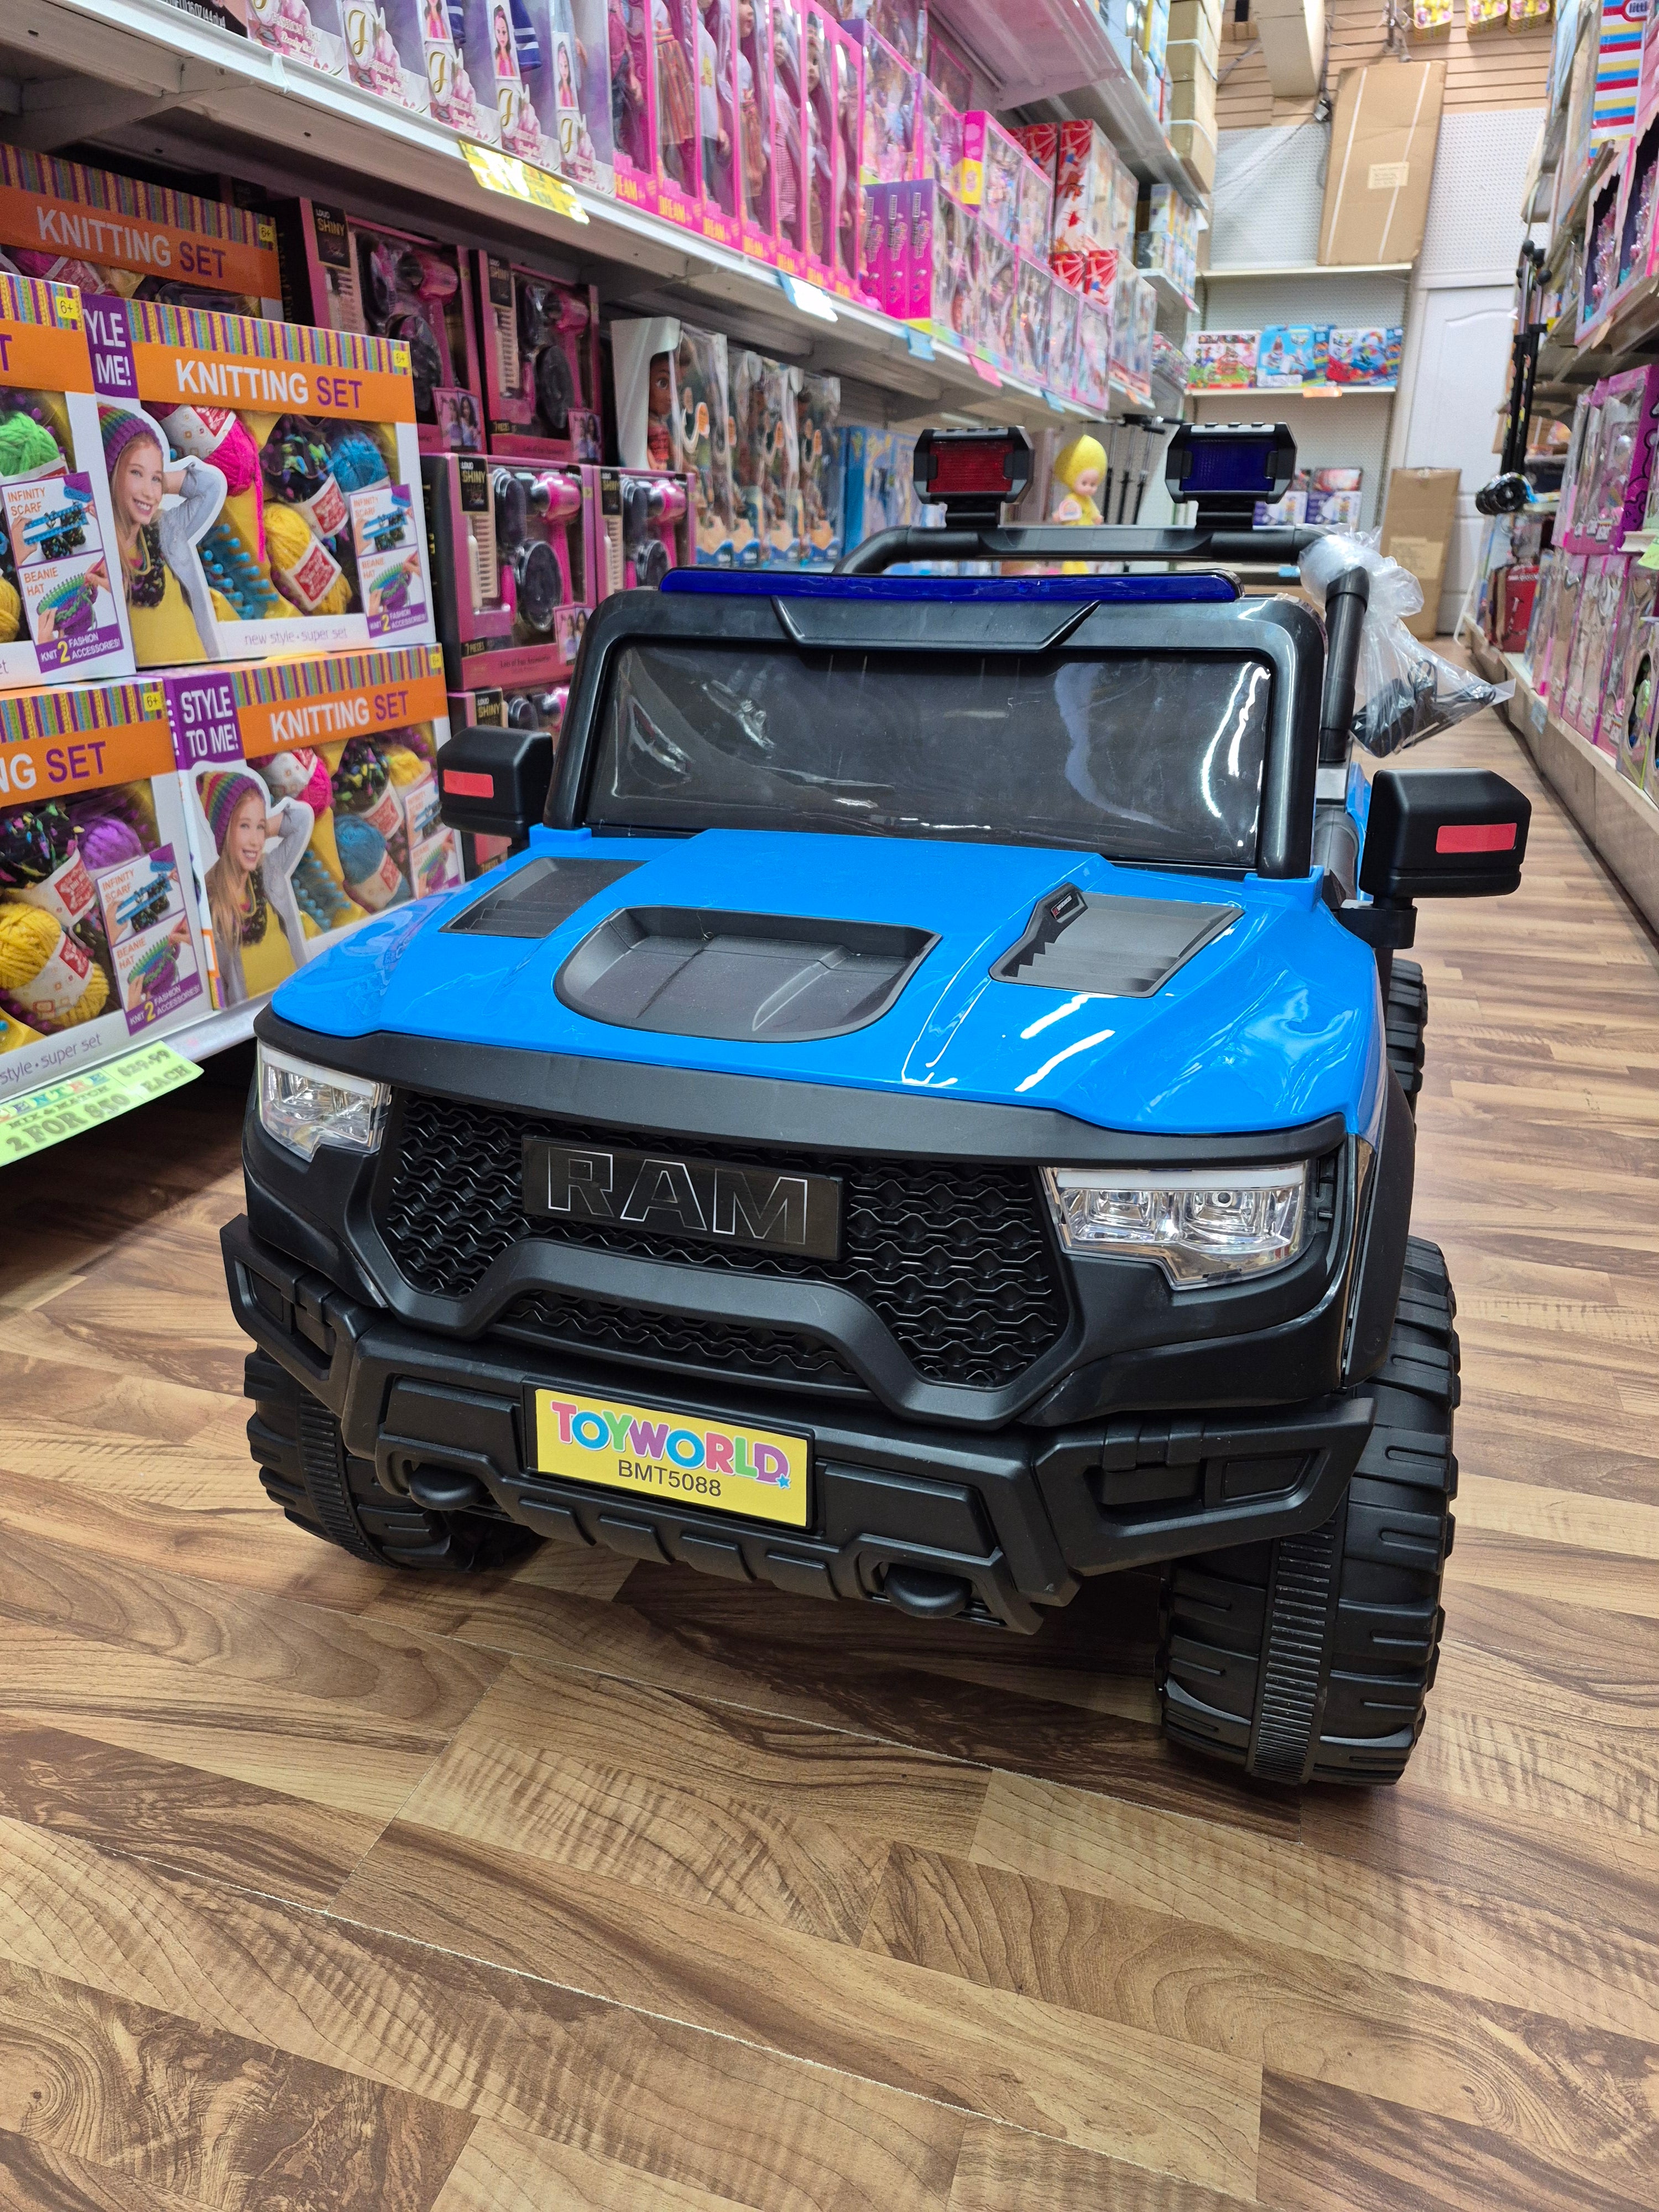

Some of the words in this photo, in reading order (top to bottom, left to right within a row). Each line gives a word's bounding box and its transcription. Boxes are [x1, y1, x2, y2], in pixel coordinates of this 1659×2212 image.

[36, 206, 171, 267] KNITTING
[179, 241, 227, 278] SET
[60, 300, 73, 315] 6+
[96, 355, 132, 387] ME!
[175, 359, 309, 405] KNITTING
[316, 376, 363, 409] SET
[462, 470, 486, 484] SHINY
[7, 487, 46, 503] INFINITY
[11, 502, 43, 517] SCARF
[24, 567, 59, 584] BEANIE
[27, 583, 45, 597] HAT
[382, 614, 391, 631] 2
[68, 632, 99, 648] FASHION
[244, 633, 267, 645] new
[270, 629, 295, 644] style
[301, 629, 329, 643] super
[332, 627, 347, 640] set
[40, 649, 58, 662] KNIT
[57, 640, 71, 664] 2
[147, 696, 158, 707] 6+
[181, 685, 233, 724] STYLE
[269, 697, 371, 743] KNITTING
[374, 690, 409, 722] SET
[186, 727, 208, 758] TO
[211, 723, 239, 755] ME!
[45, 741, 107, 782] SET
[101, 869, 135, 891] INFINITY
[104, 884, 132, 904] SCARF
[116, 938, 147, 958] BEANIE
[118, 956, 135, 970] HAT
[144, 1001, 156, 1022] 2
[0, 1058, 33, 1085] style
[41, 1046, 77, 1069] super
[82, 1033, 102, 1050] set
[140, 1064, 192, 1093] EACH
[6, 1136, 29, 1151] 2
[23, 1112, 88, 1143] FOR
[547, 1147, 808, 1245] RAM
[551, 1400, 791, 1488] TOYWORLD
[618, 1459, 722, 1497] BMT5088
